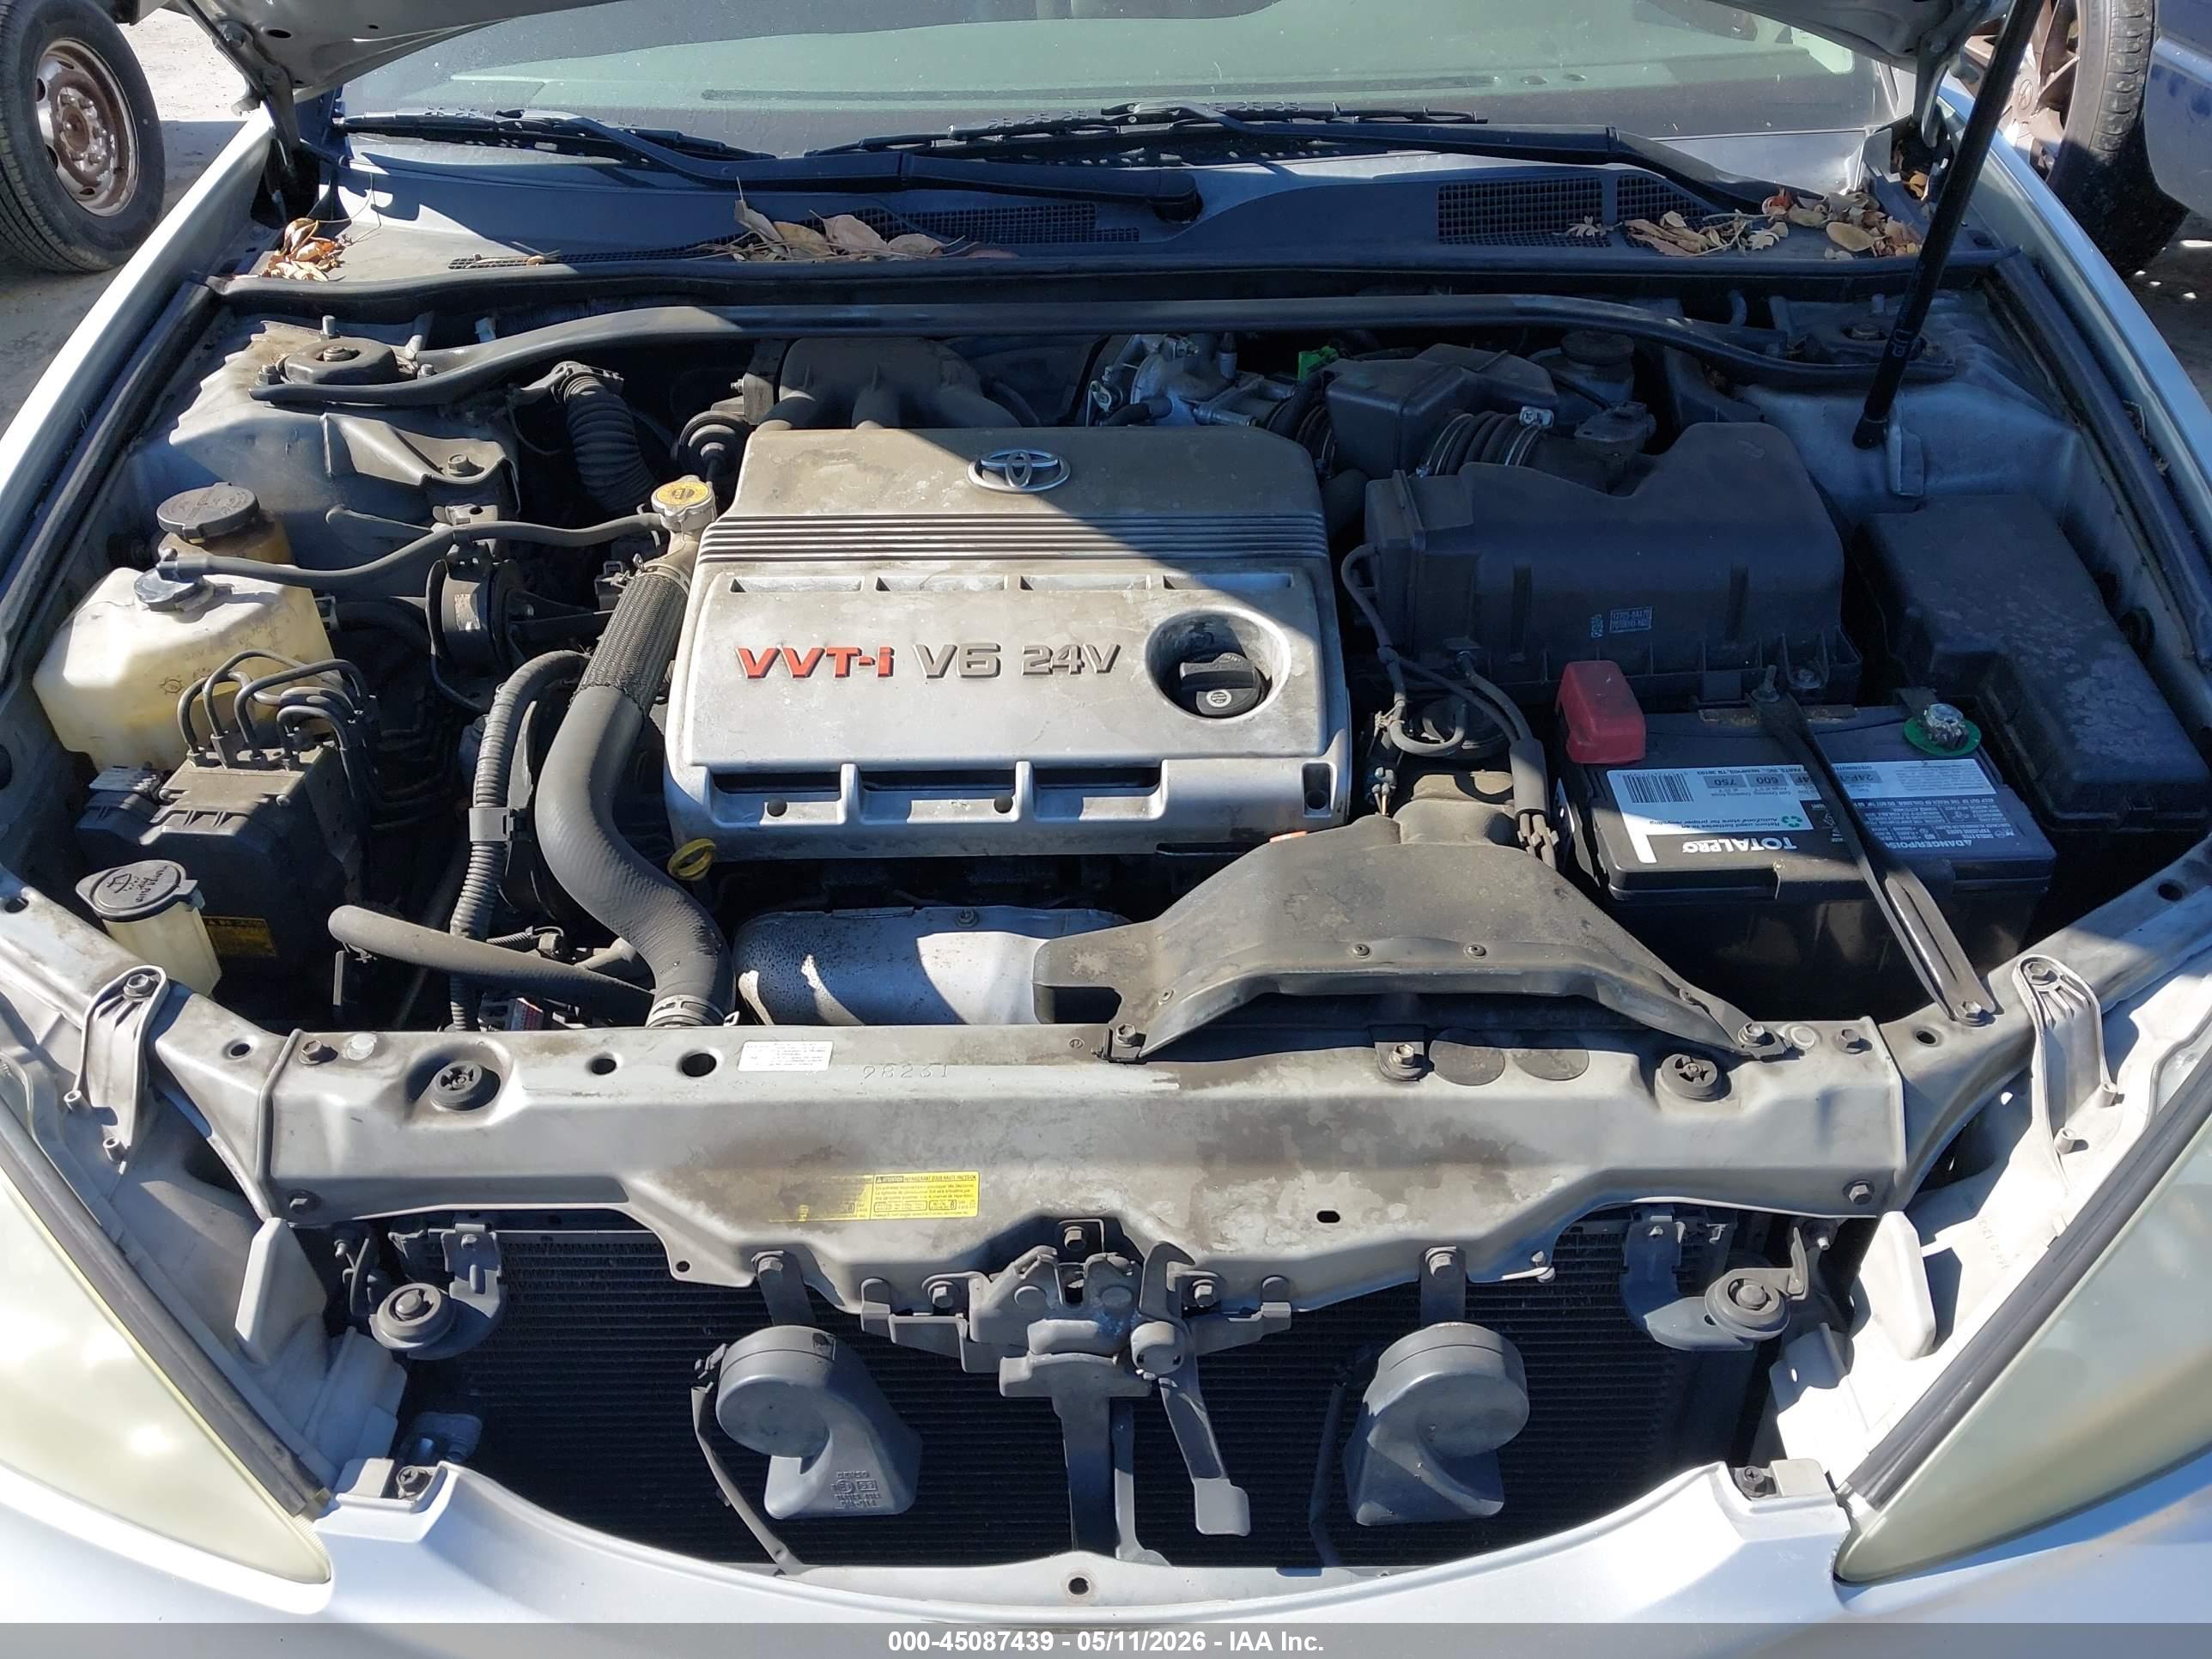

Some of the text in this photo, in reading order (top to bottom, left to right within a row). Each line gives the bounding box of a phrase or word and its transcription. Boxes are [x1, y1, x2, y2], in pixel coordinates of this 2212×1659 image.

[736, 643, 1121, 679] VVT-i V6 24V
[1682, 836, 1798, 854] TOTALPRO
